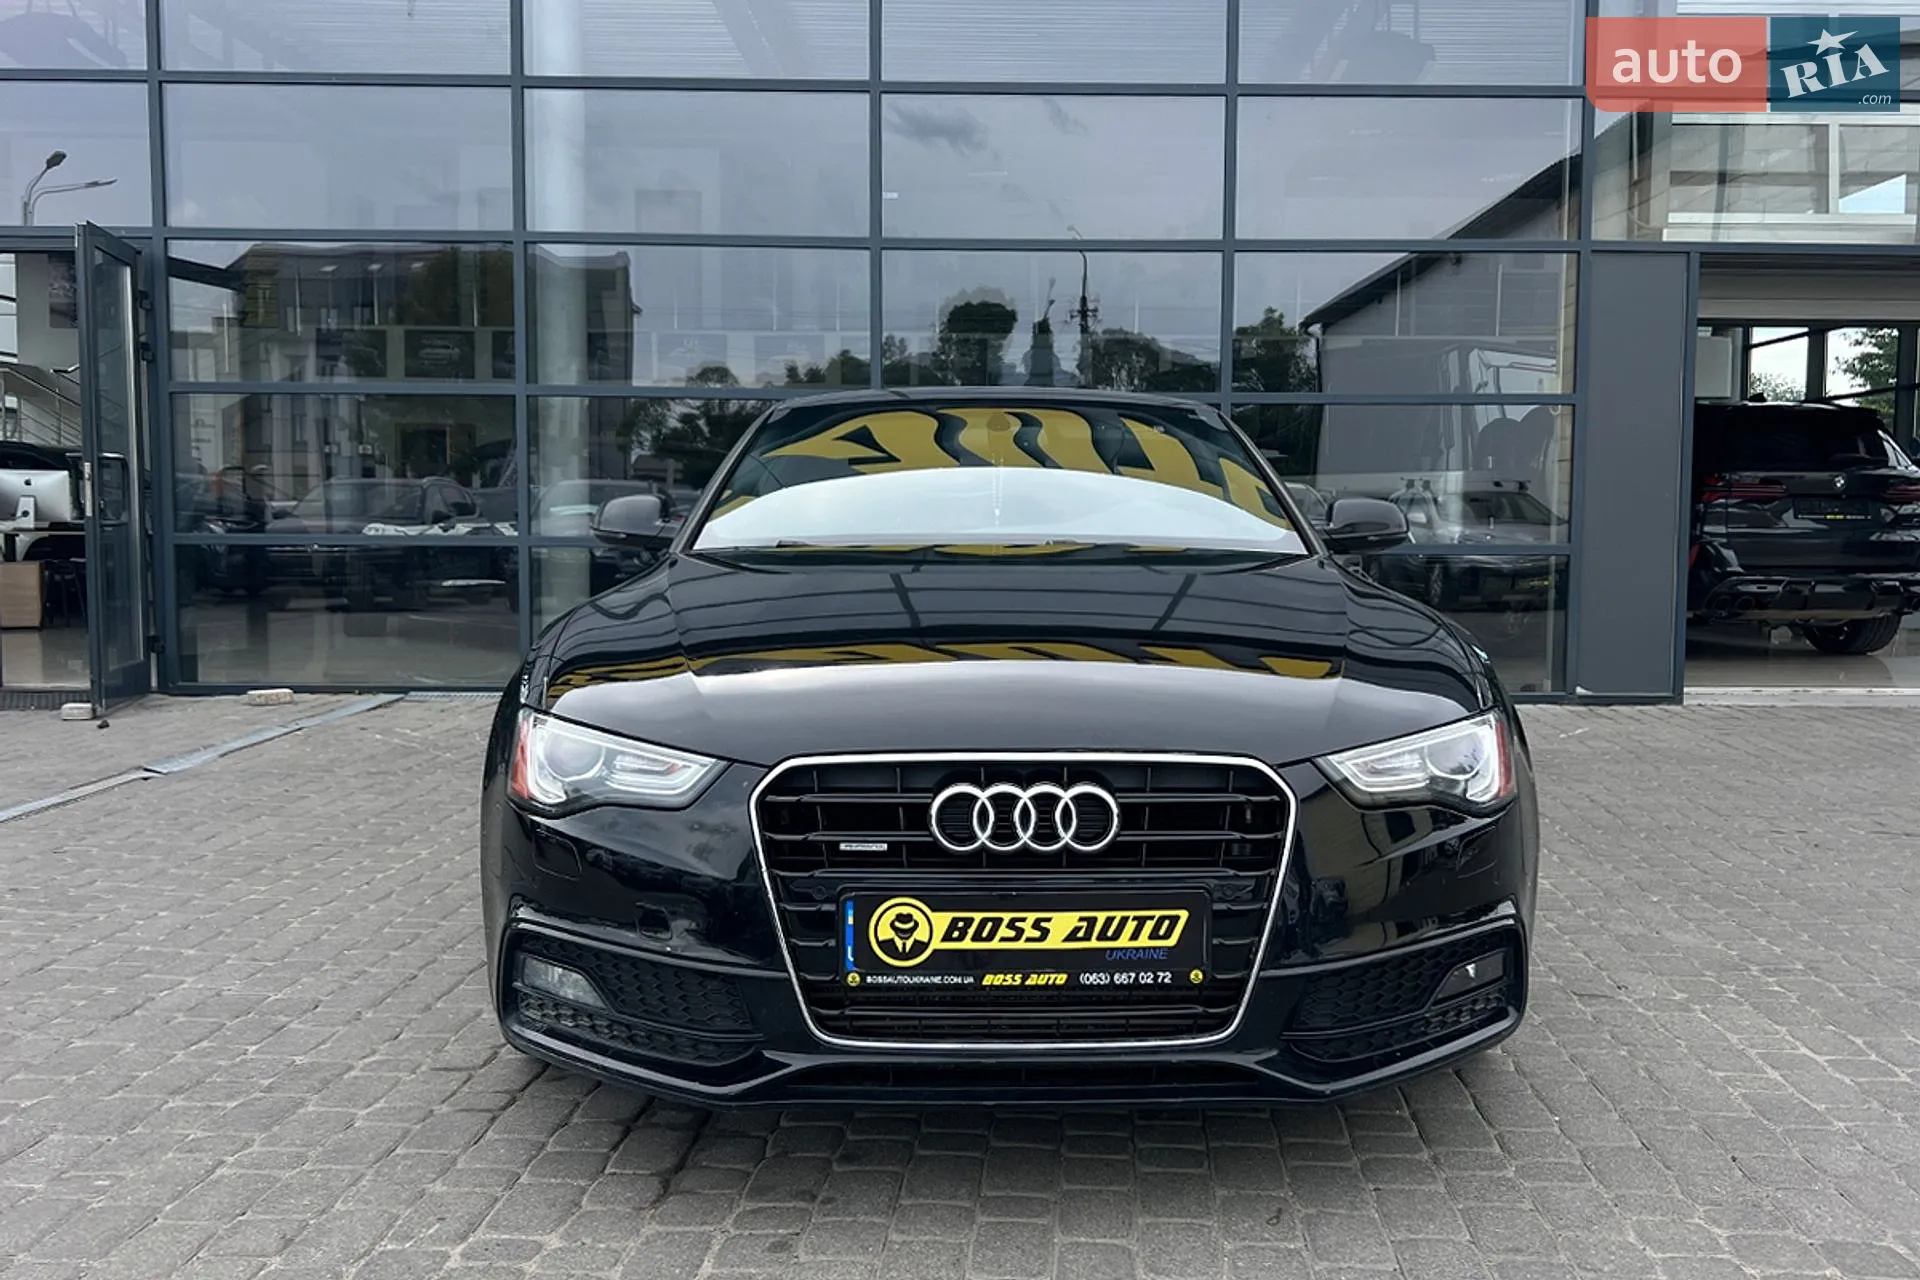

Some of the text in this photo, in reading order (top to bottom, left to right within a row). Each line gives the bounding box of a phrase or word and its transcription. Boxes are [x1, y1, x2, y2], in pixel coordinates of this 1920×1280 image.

[941, 914, 1181, 943] BOSS AUTO
[1105, 948, 1169, 960] UKRAINE
[982, 973, 1068, 985] BOSS AUTO
[1080, 972, 1172, 985] (063) 667 02 72
